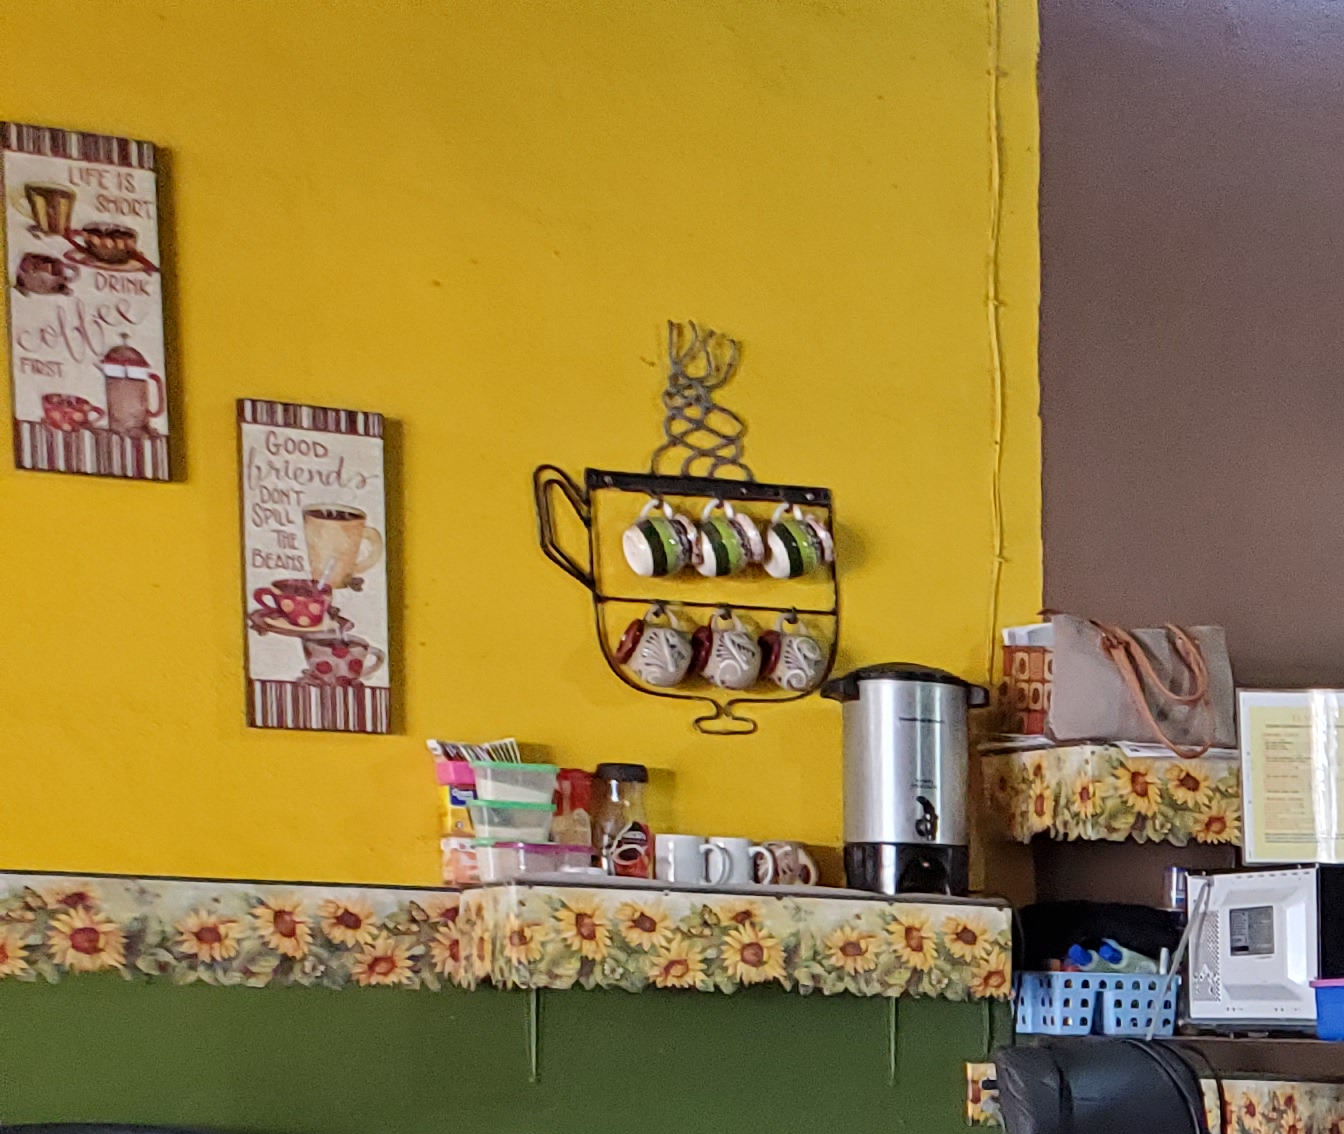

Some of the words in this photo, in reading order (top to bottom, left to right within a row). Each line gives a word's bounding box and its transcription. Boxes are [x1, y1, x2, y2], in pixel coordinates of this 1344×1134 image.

[67, 165, 111, 192] LIFE
[117, 173, 136, 192] IS
[95, 195, 153, 219] SHORT
[95, 273, 151, 296] DRINK
[20, 357, 64, 378] FIRST
[265, 430, 329, 458] GOOD
[252, 502, 295, 528] SPILL
[271, 529, 299, 550] THE
[252, 548, 304, 572] BEANS
